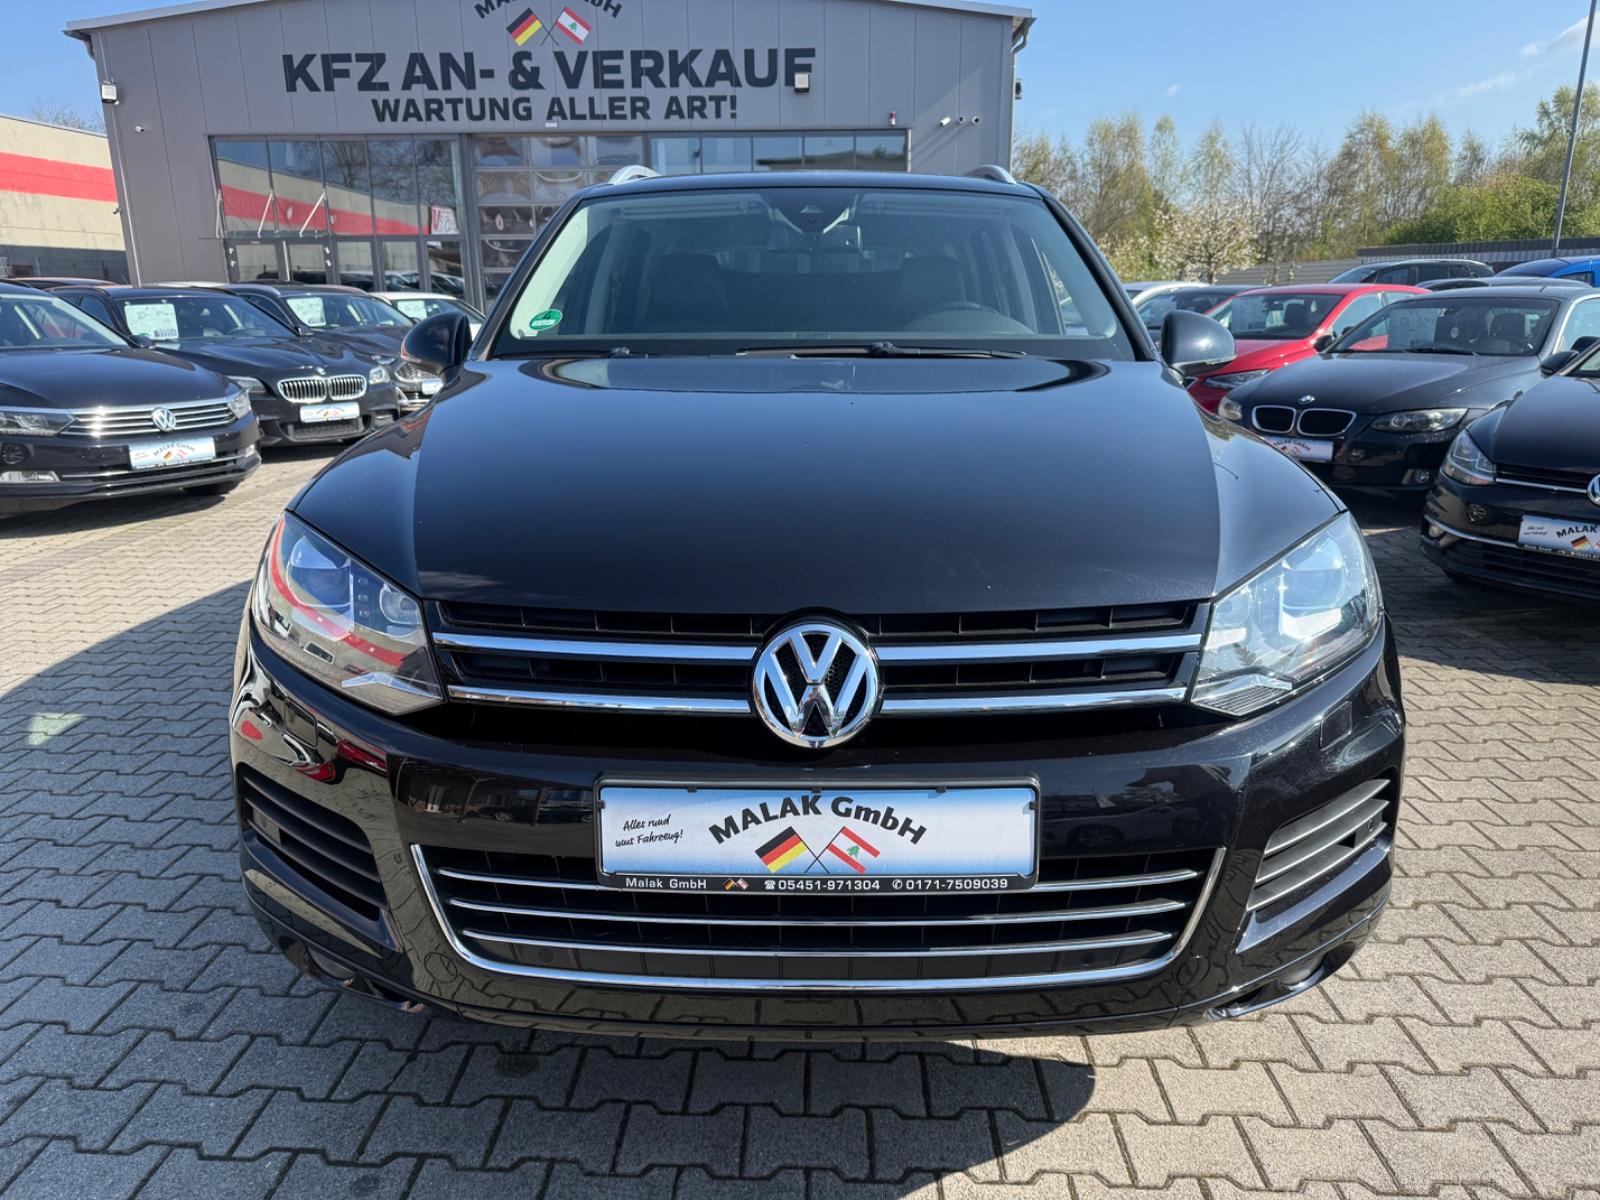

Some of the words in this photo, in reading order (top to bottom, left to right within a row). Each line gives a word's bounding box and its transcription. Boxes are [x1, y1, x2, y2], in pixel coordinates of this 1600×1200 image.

[282, 52, 389, 92] KFZ
[401, 51, 494, 91] AN-
[508, 50, 545, 90] &
[553, 48, 815, 89] VERKAUF
[371, 97, 532, 122] WARTUNG
[546, 95, 650, 121] ALLER
[664, 95, 737, 120] ART!
[1556, 525, 1597, 538] MALAK
[623, 819, 645, 831] Alles
[648, 813, 671, 827] rund
[709, 795, 822, 844] MALAK
[831, 796, 927, 844] GmbH
[637, 829, 683, 844] Fahrzeug!
[625, 878, 663, 889] Malak
[669, 879, 707, 889] GmbH
[778, 880, 880, 890] 05451-971304
[905, 879, 1008, 889] 0171-7509039
